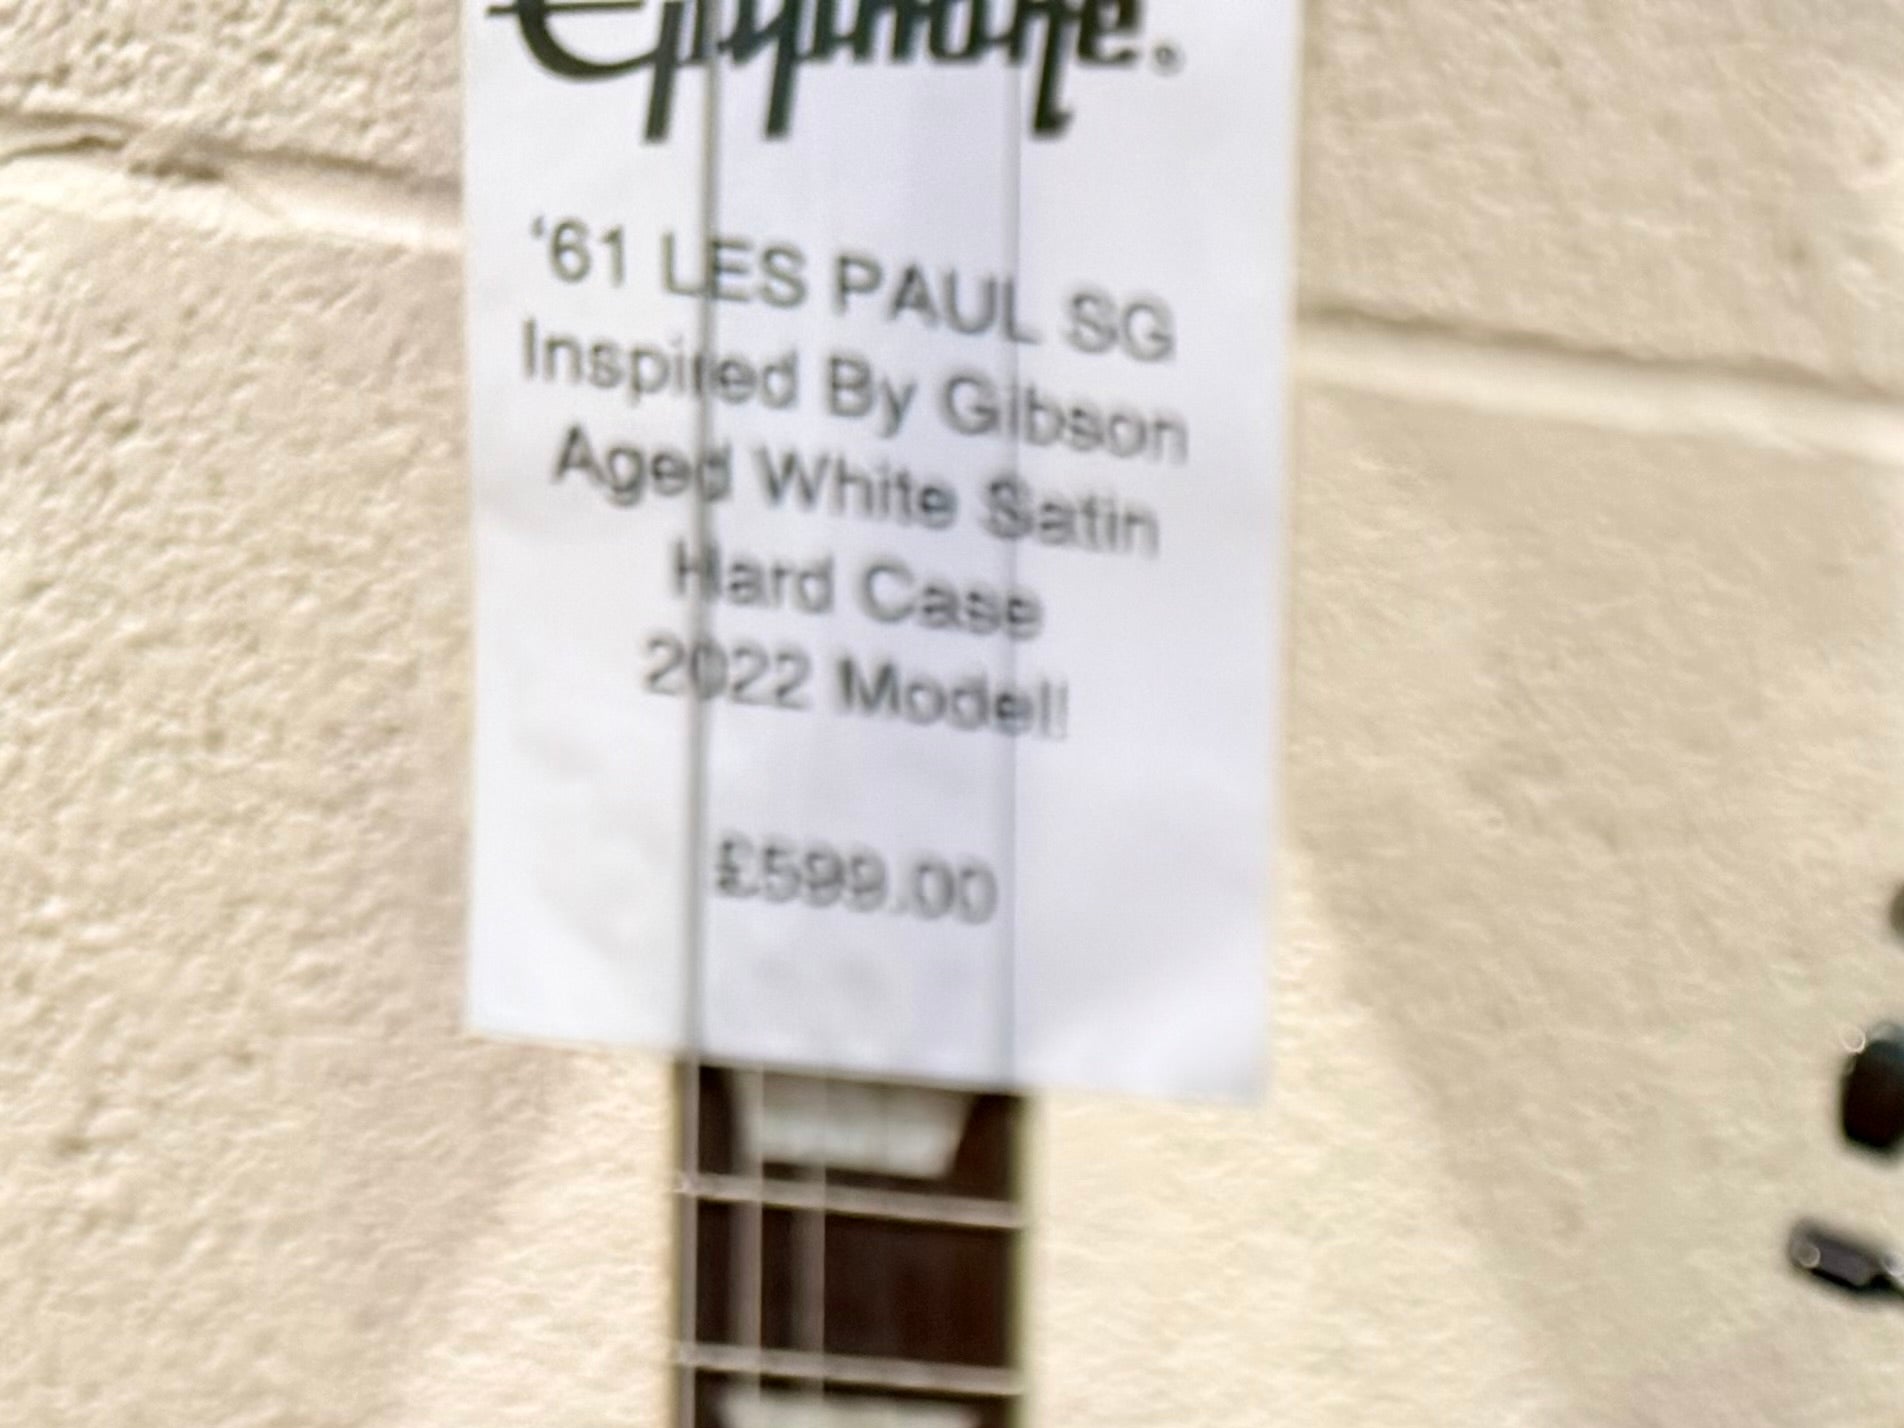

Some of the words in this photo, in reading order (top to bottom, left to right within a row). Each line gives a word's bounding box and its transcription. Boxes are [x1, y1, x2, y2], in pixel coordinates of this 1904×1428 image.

[660, 230, 808, 309] LES
[833, 252, 1042, 344] PAUL
[1064, 290, 1178, 364] SG
[521, 316, 801, 409] Inspired
[825, 352, 918, 440] By
[940, 371, 1192, 465] Gibson
[552, 421, 735, 508] Aged
[754, 444, 958, 531] White
[980, 470, 1160, 557] Satin
[671, 537, 836, 615] Hard
[860, 555, 1045, 641] Case
[643, 634, 813, 711] 2022
[714, 832, 998, 925] £599.00
